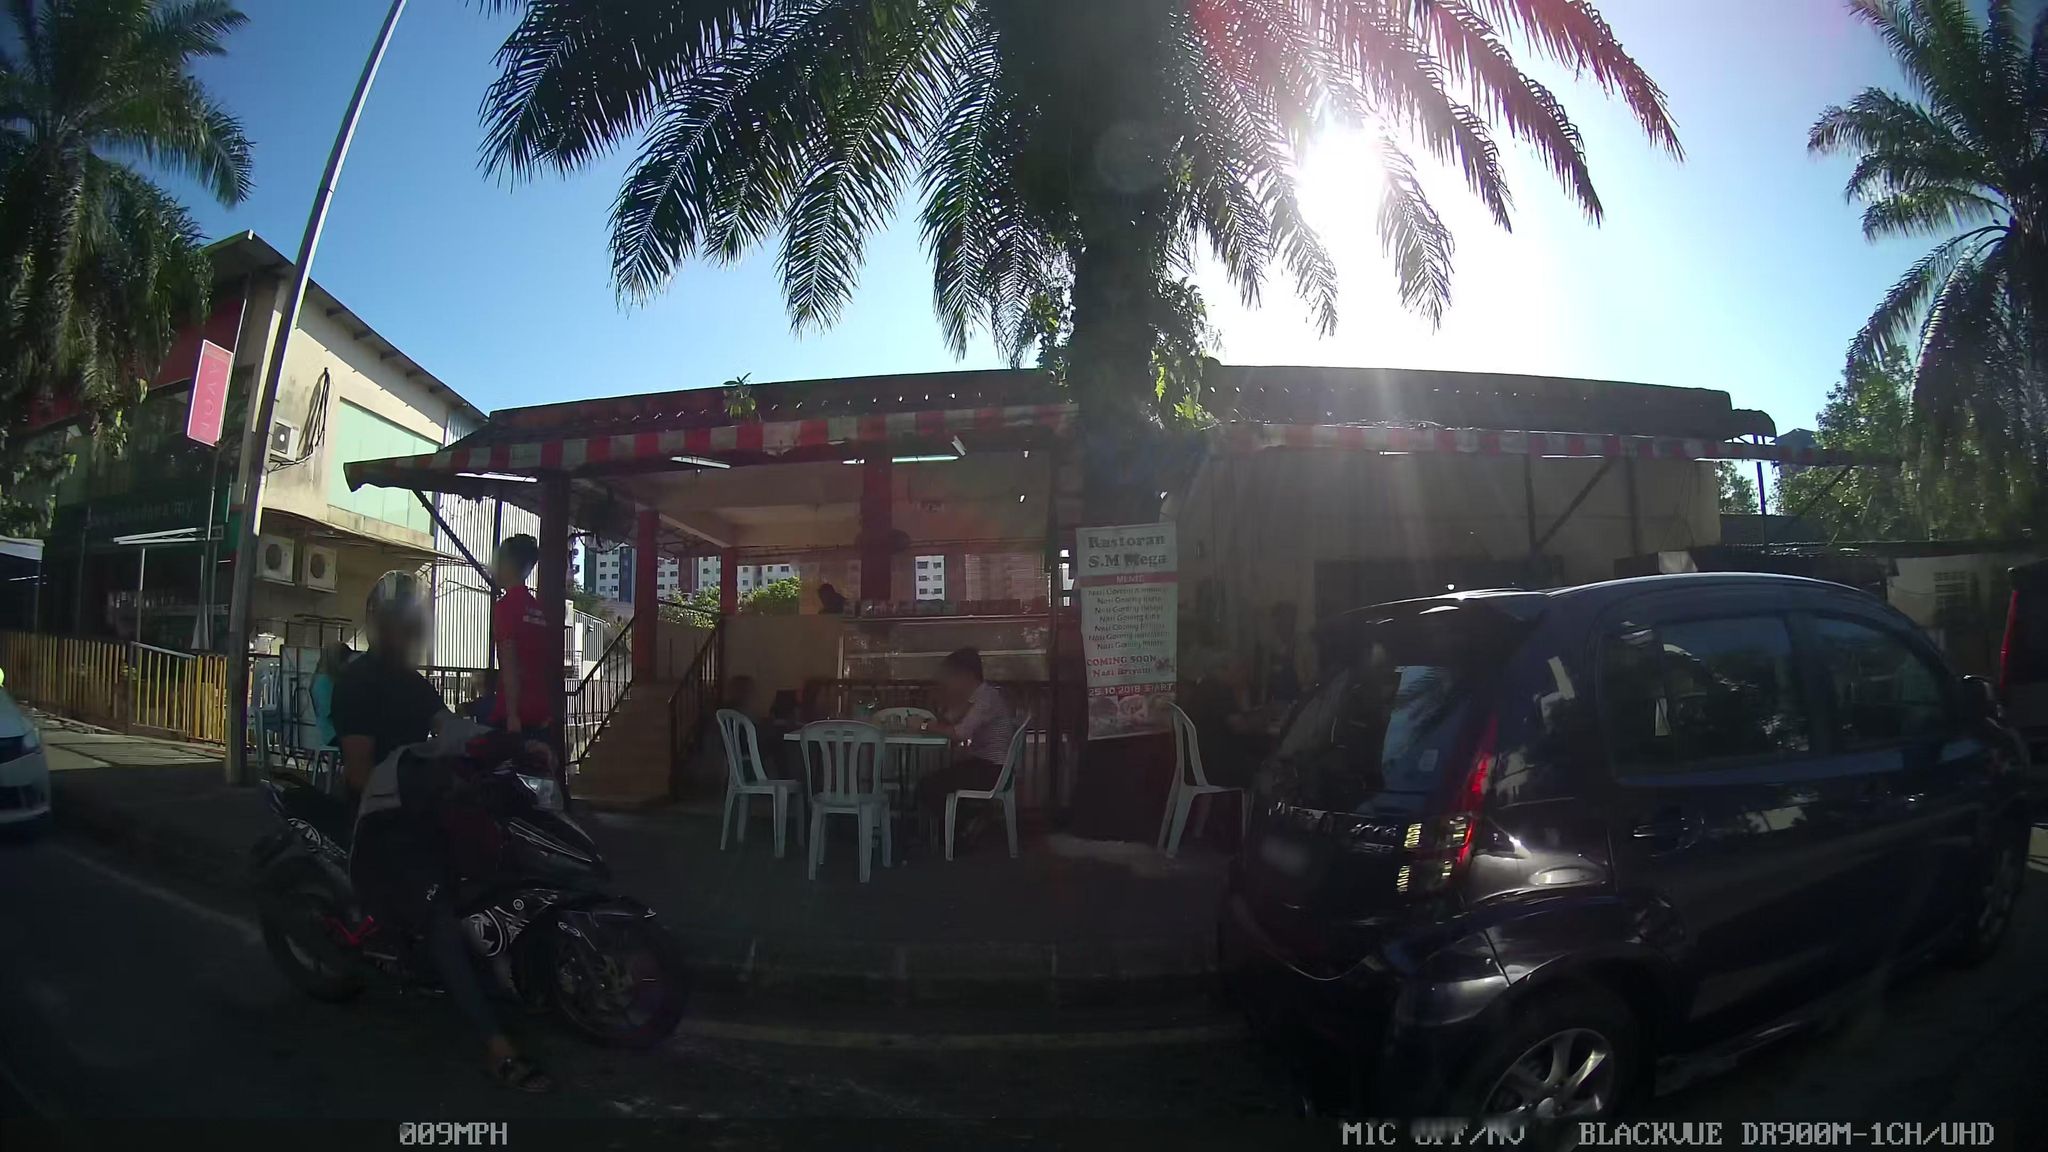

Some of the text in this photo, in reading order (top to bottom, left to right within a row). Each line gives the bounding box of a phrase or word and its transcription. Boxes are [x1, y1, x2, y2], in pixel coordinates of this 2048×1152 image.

[1088, 553, 1120, 568] S.M
[1087, 654, 1156, 666] COMING SOON
